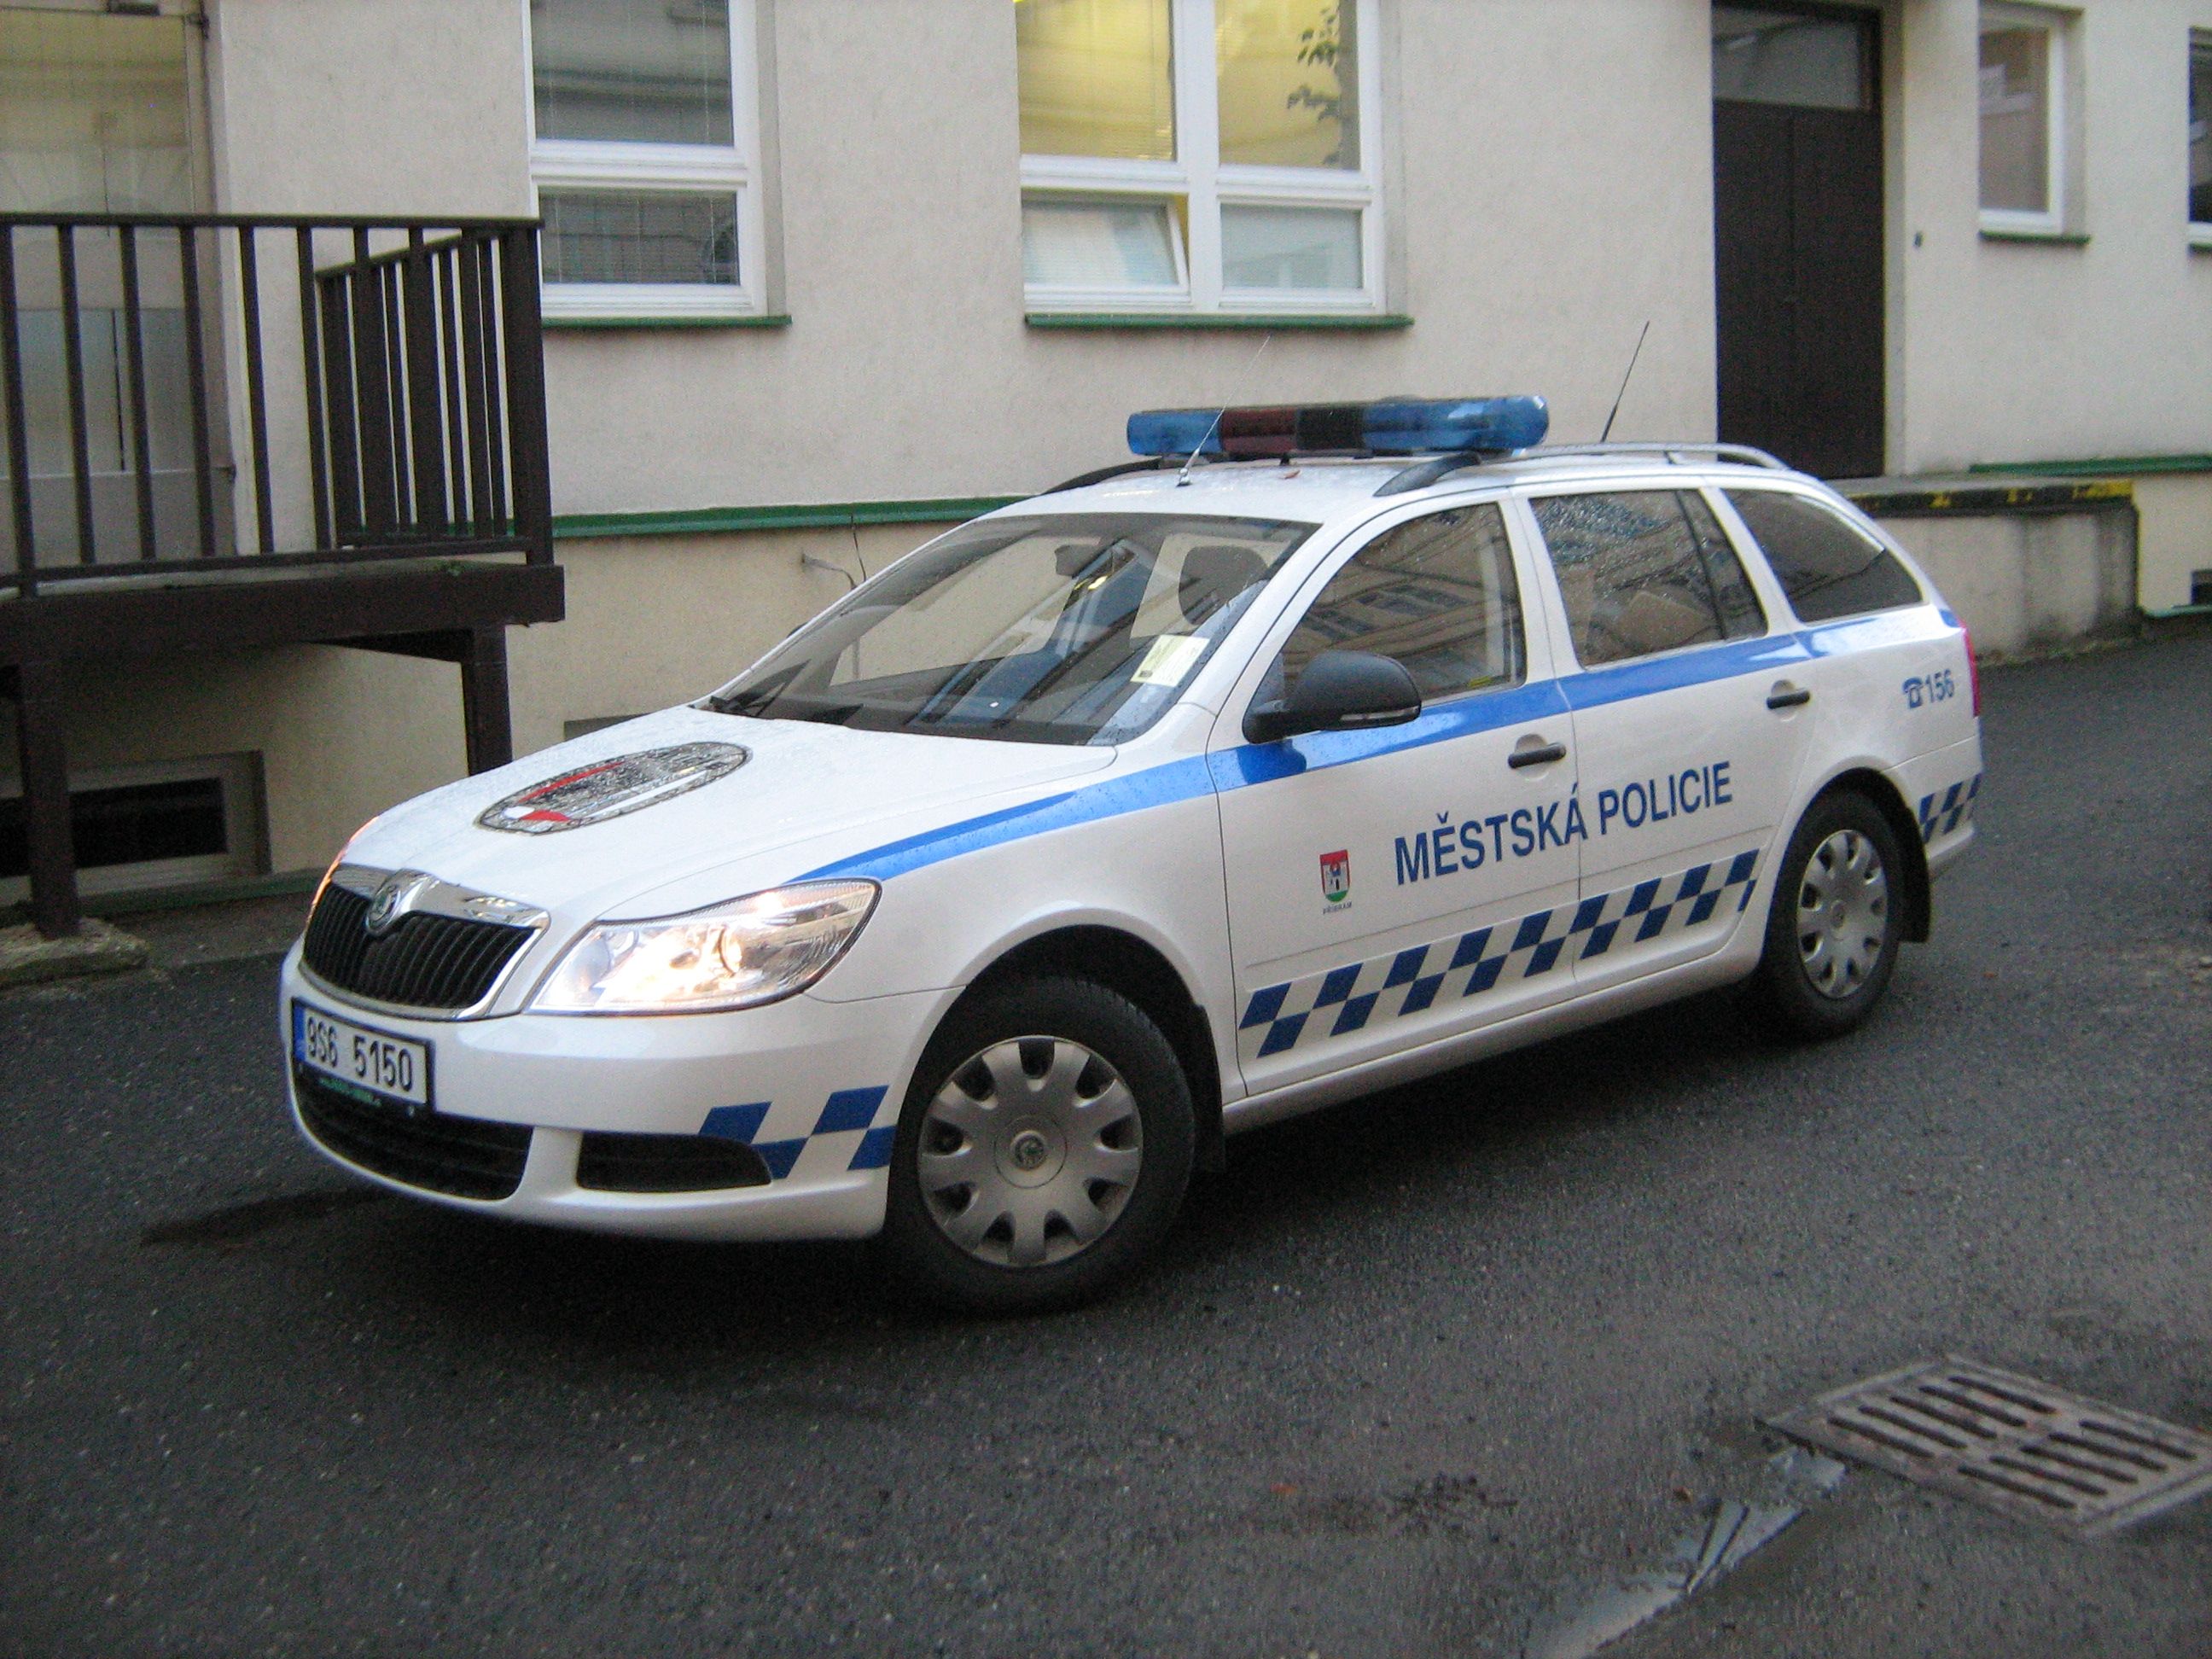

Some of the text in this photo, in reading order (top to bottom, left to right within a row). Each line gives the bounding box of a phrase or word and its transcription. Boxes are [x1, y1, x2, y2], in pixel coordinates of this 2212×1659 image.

[1924, 668, 1954, 702] 156
[1394, 760, 1733, 886] MĚSTSKÁ POLICIE
[307, 1016, 338, 1067] 9S6
[352, 1034, 412, 1092] 5150
